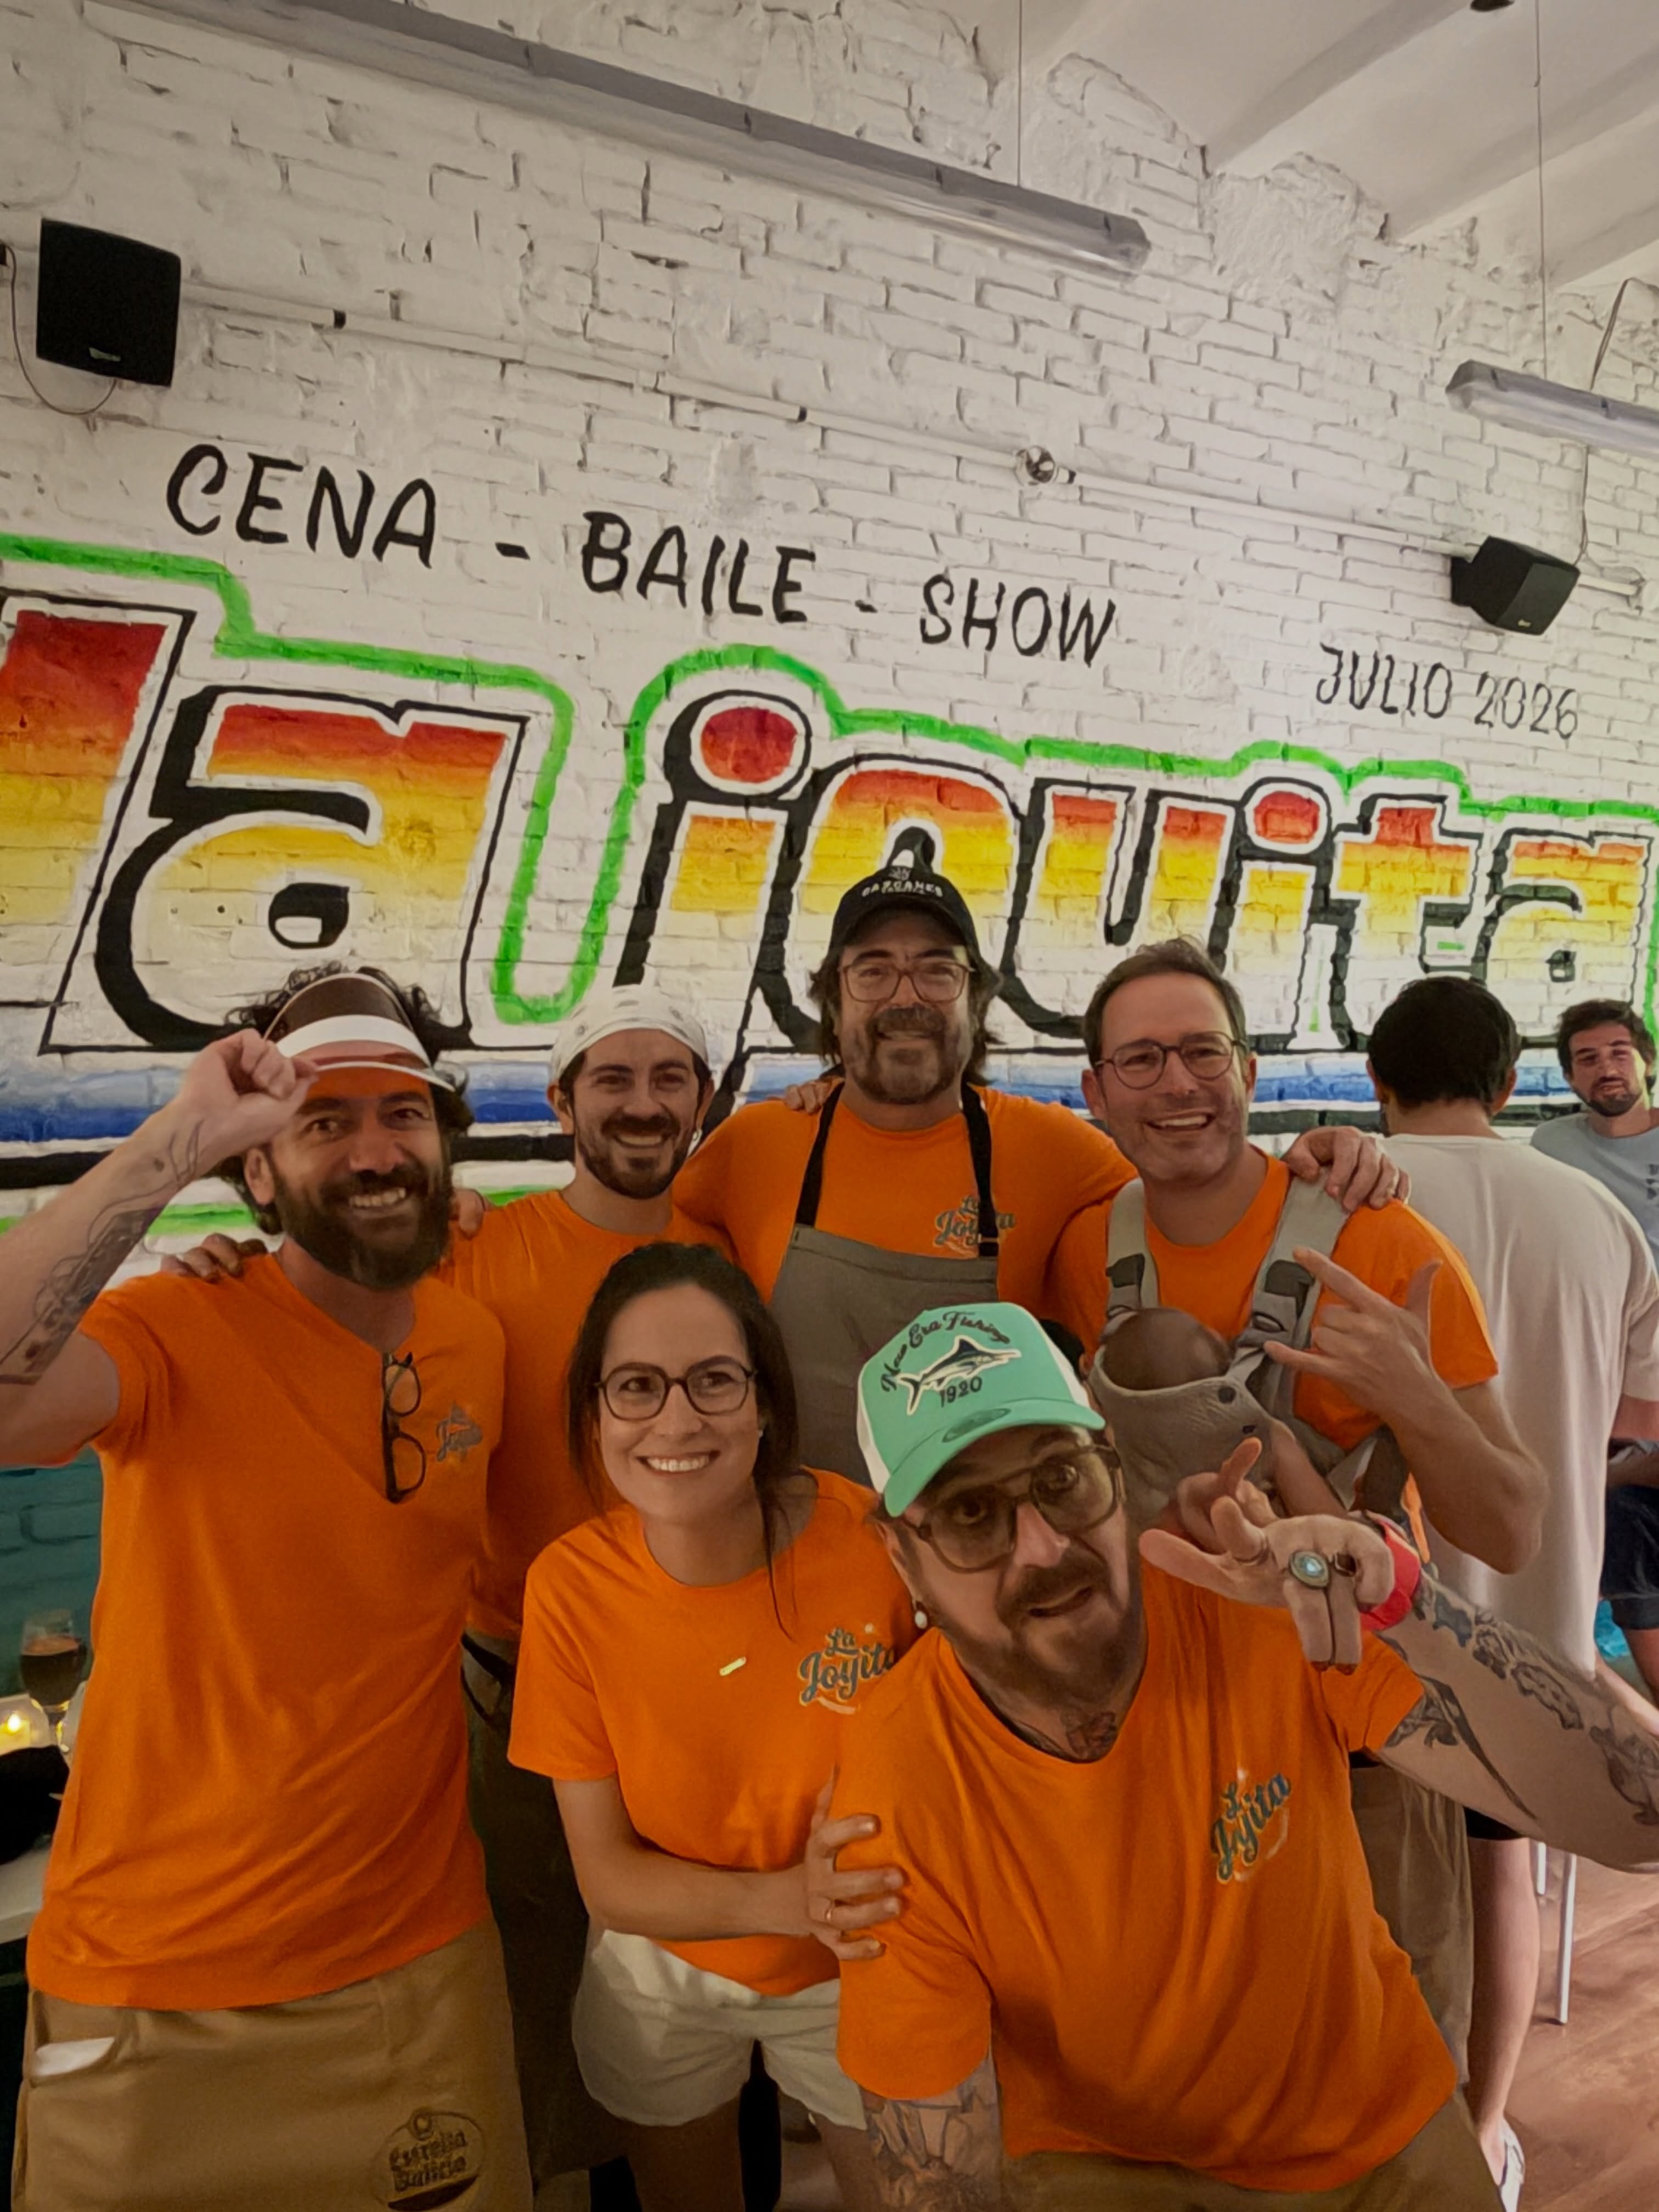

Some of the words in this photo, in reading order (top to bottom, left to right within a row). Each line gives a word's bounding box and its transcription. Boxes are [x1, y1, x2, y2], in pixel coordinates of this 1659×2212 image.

[166, 444, 436, 569] CENA
[582, 511, 816, 624] BAILE
[920, 573, 1115, 668] SHOW
[1316, 642, 1453, 719] JULIO
[1474, 671, 1578, 740] 2026
[909, 1323, 942, 1349] Era
[942, 1311, 1011, 1345] Fishing
[939, 1376, 983, 1408] 1920
[824, 1627, 859, 1657] La
